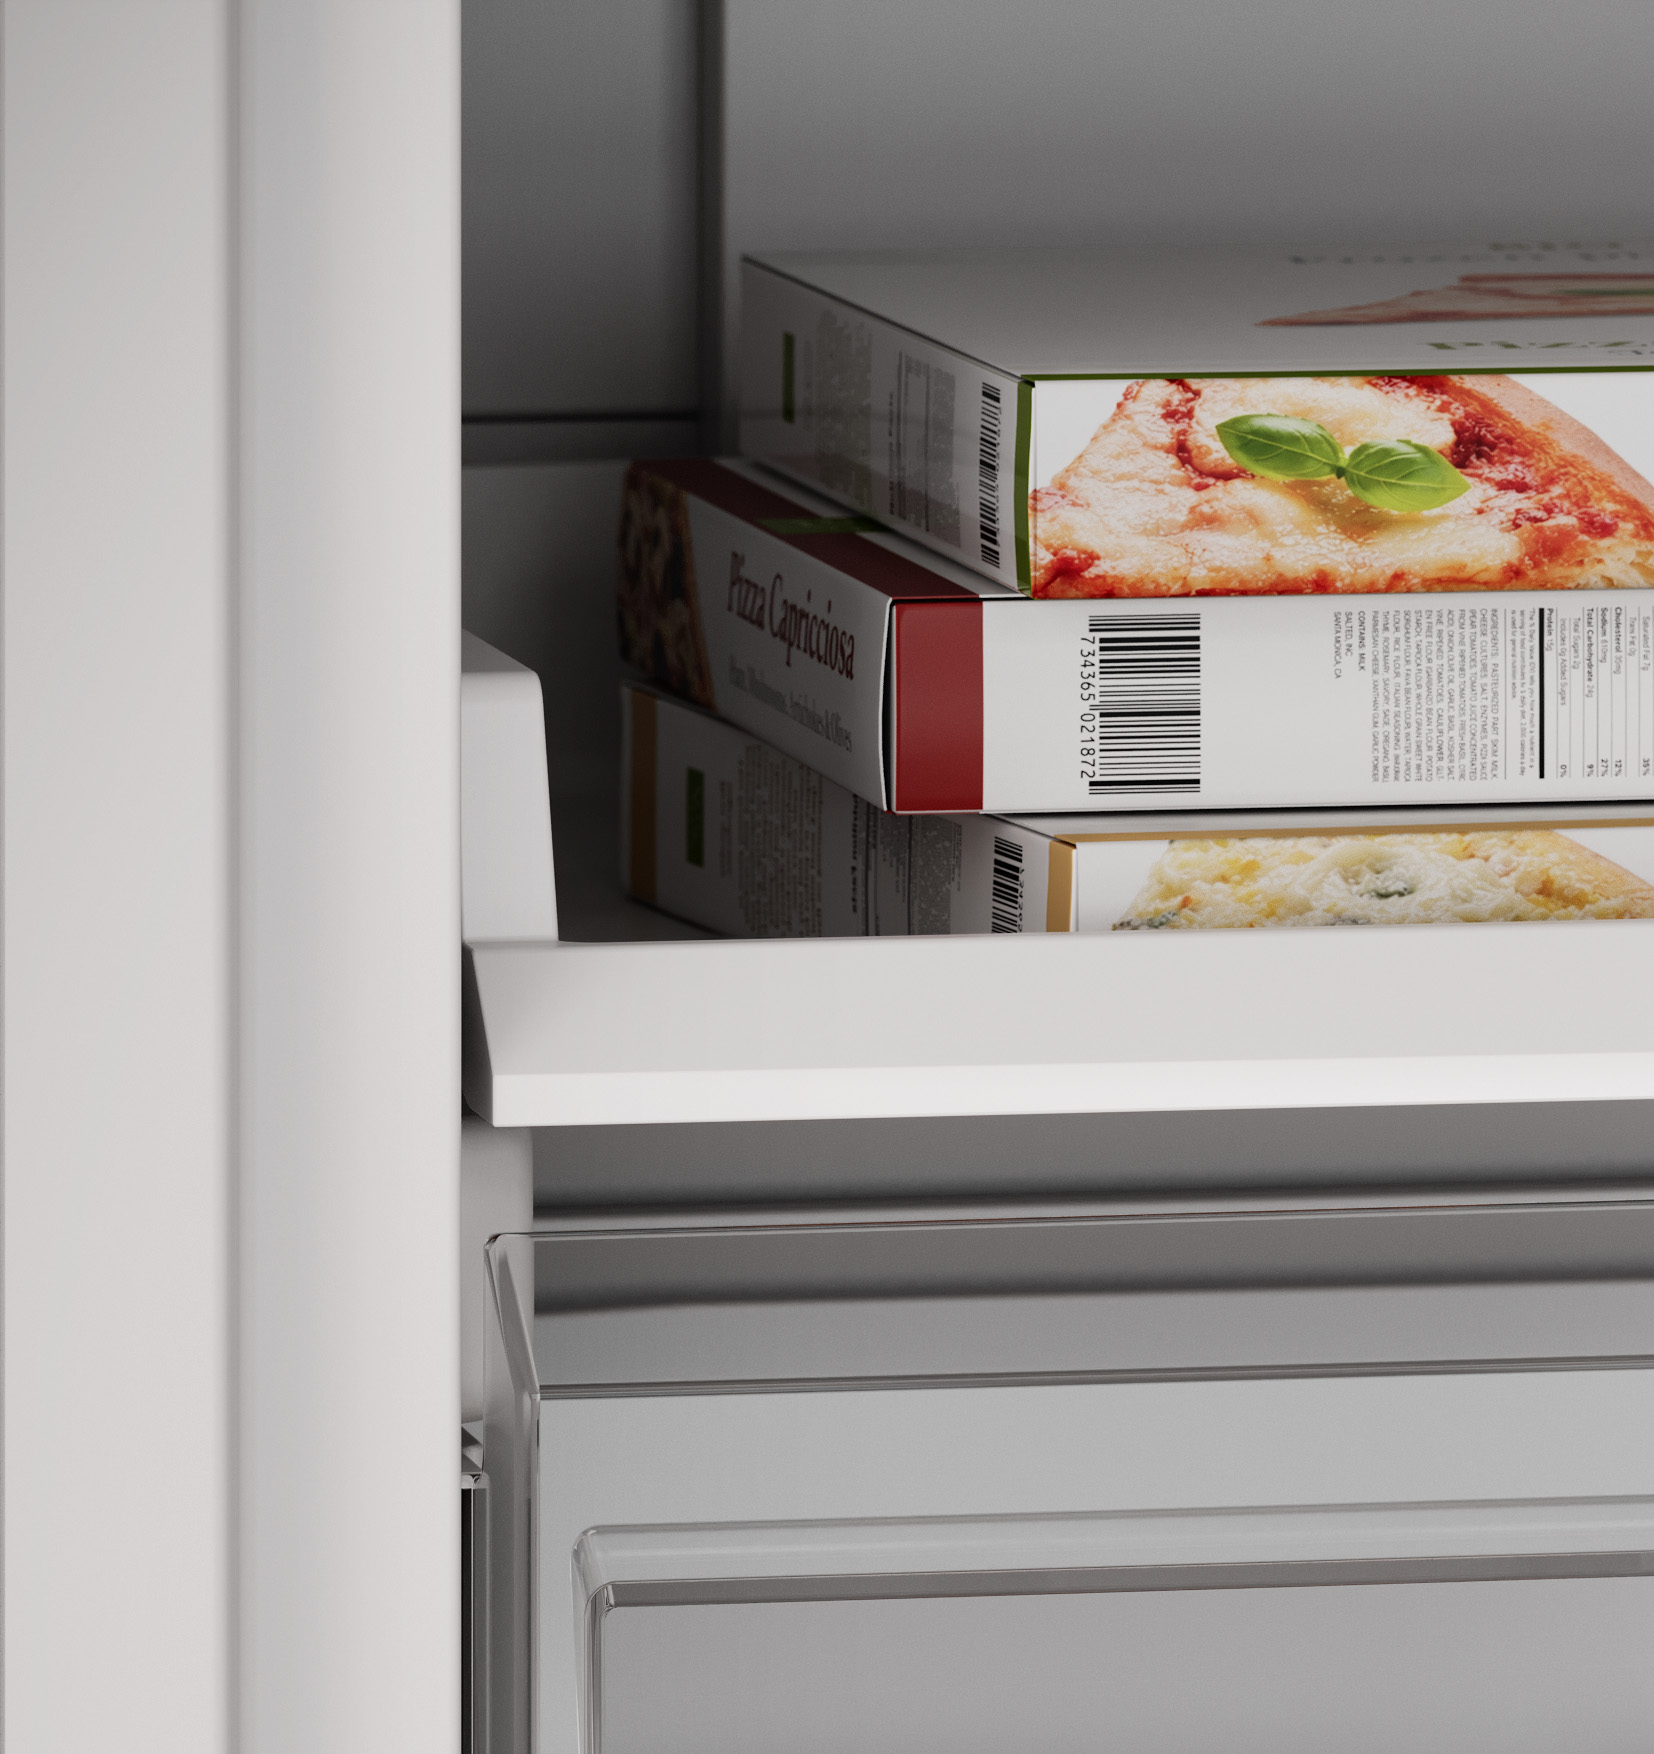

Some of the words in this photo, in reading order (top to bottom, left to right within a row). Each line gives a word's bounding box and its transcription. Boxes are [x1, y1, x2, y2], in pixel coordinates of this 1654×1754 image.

[727, 551, 766, 631] Pizza
[769, 572, 855, 681] Capricciosa
[1335, 668, 1341, 678] CA
[1080, 713, 1095, 779] 021872
